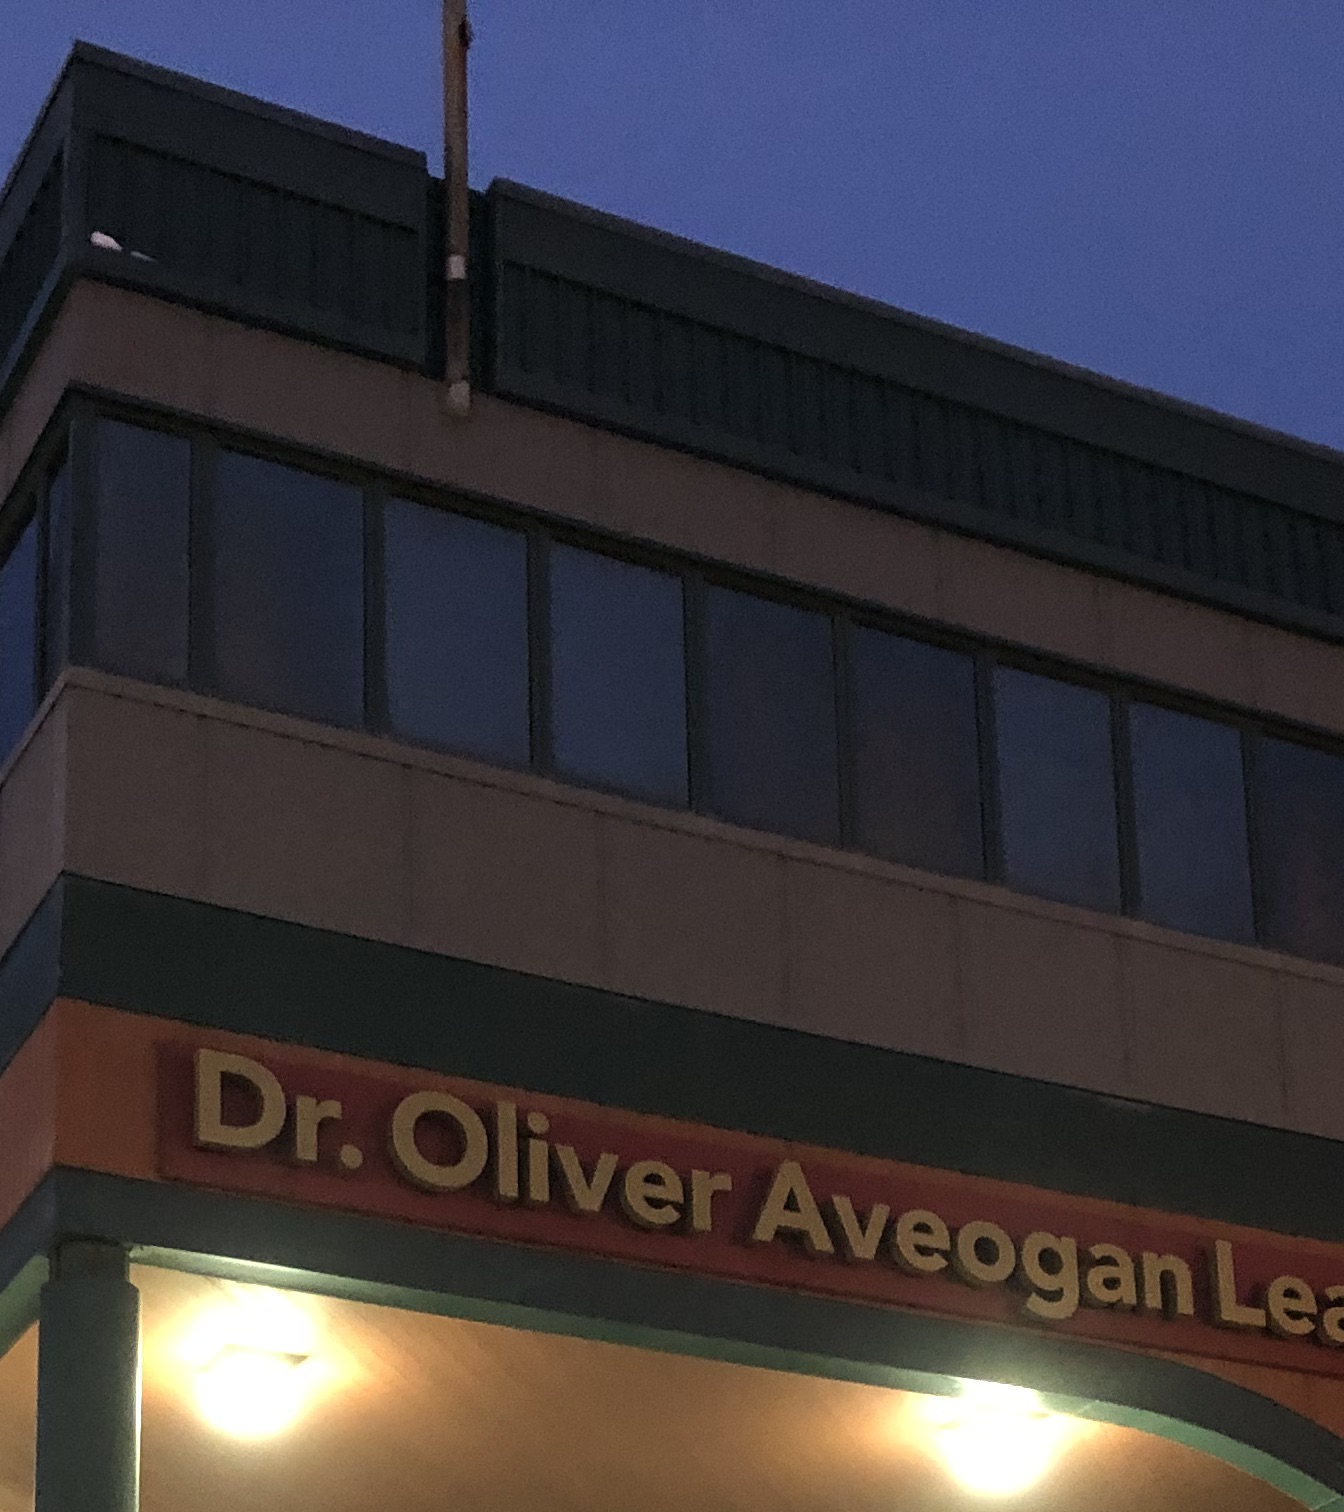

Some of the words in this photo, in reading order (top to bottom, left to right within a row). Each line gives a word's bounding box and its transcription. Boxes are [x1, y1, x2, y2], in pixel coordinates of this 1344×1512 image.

[193, 1048, 363, 1170] Dr.
[389, 1090, 733, 1234] Oliver
[750, 1160, 1193, 1321] Aveogan
